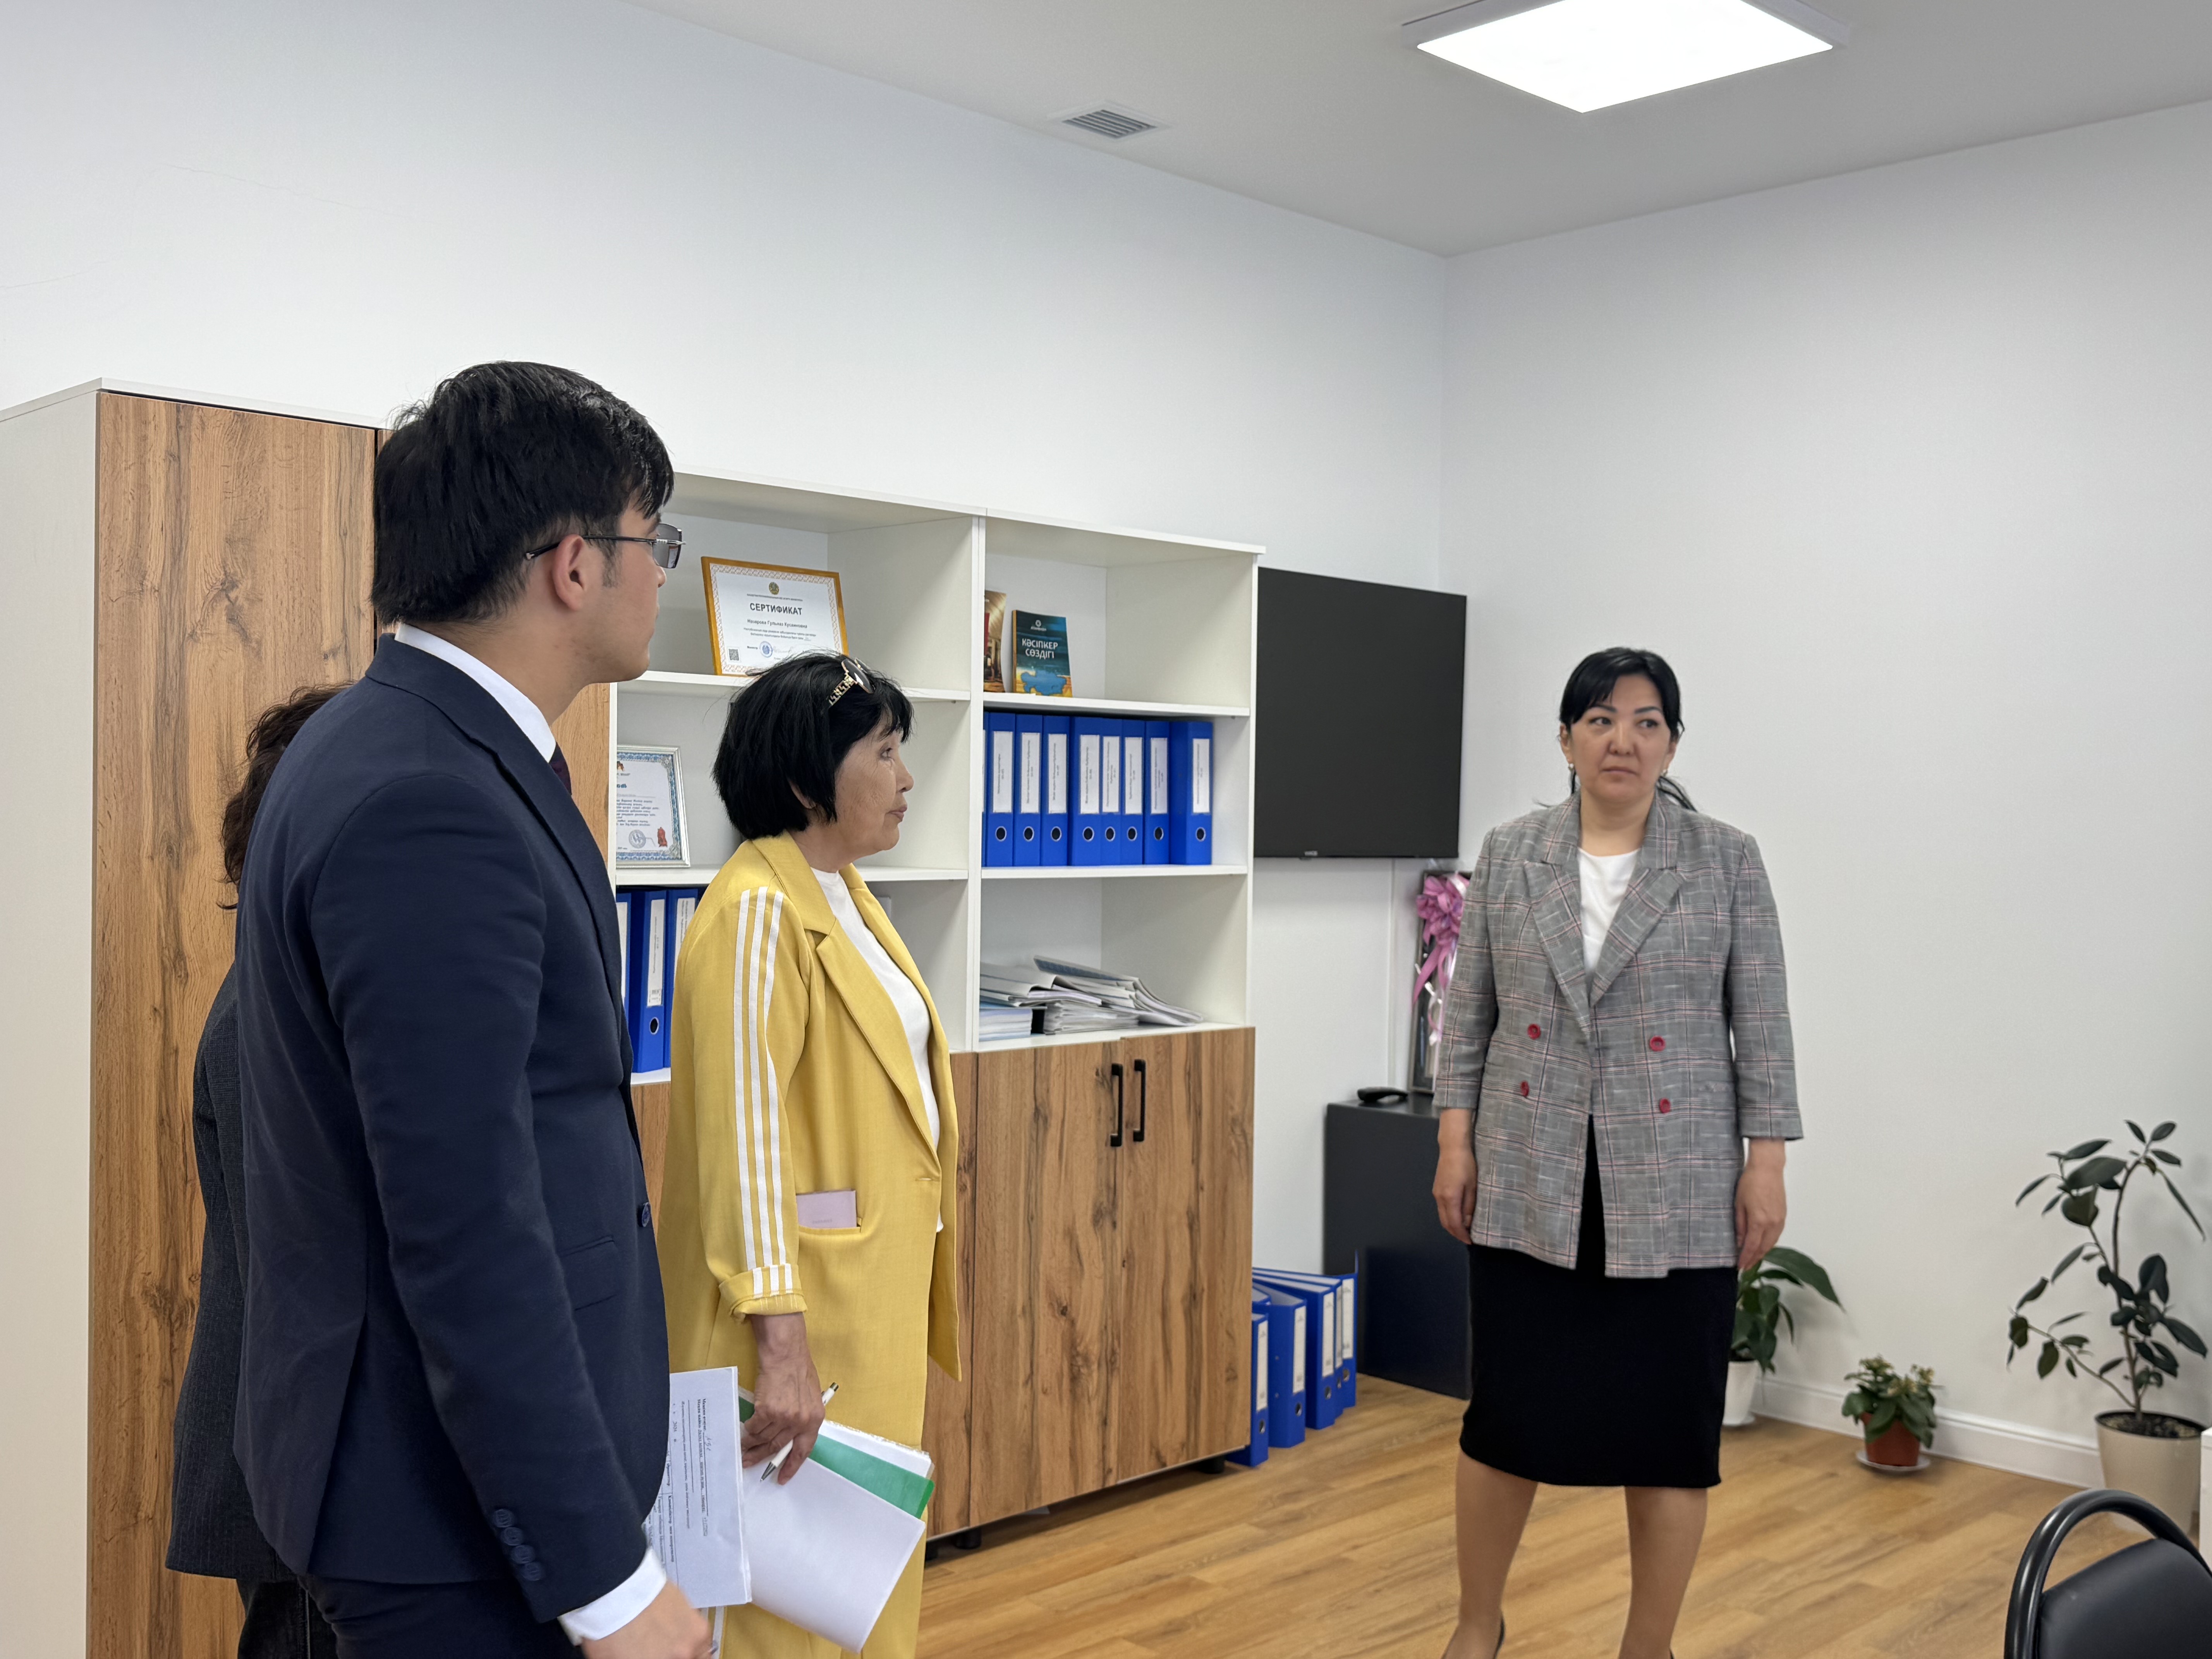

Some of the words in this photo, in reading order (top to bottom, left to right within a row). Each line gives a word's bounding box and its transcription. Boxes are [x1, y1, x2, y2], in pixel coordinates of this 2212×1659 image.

[750, 603, 802, 615] СЕРТИФИКАТ
[1022, 638, 1058, 650] КӘСІПКЕР
[1025, 648, 1054, 659] СӨЗДІГІ
